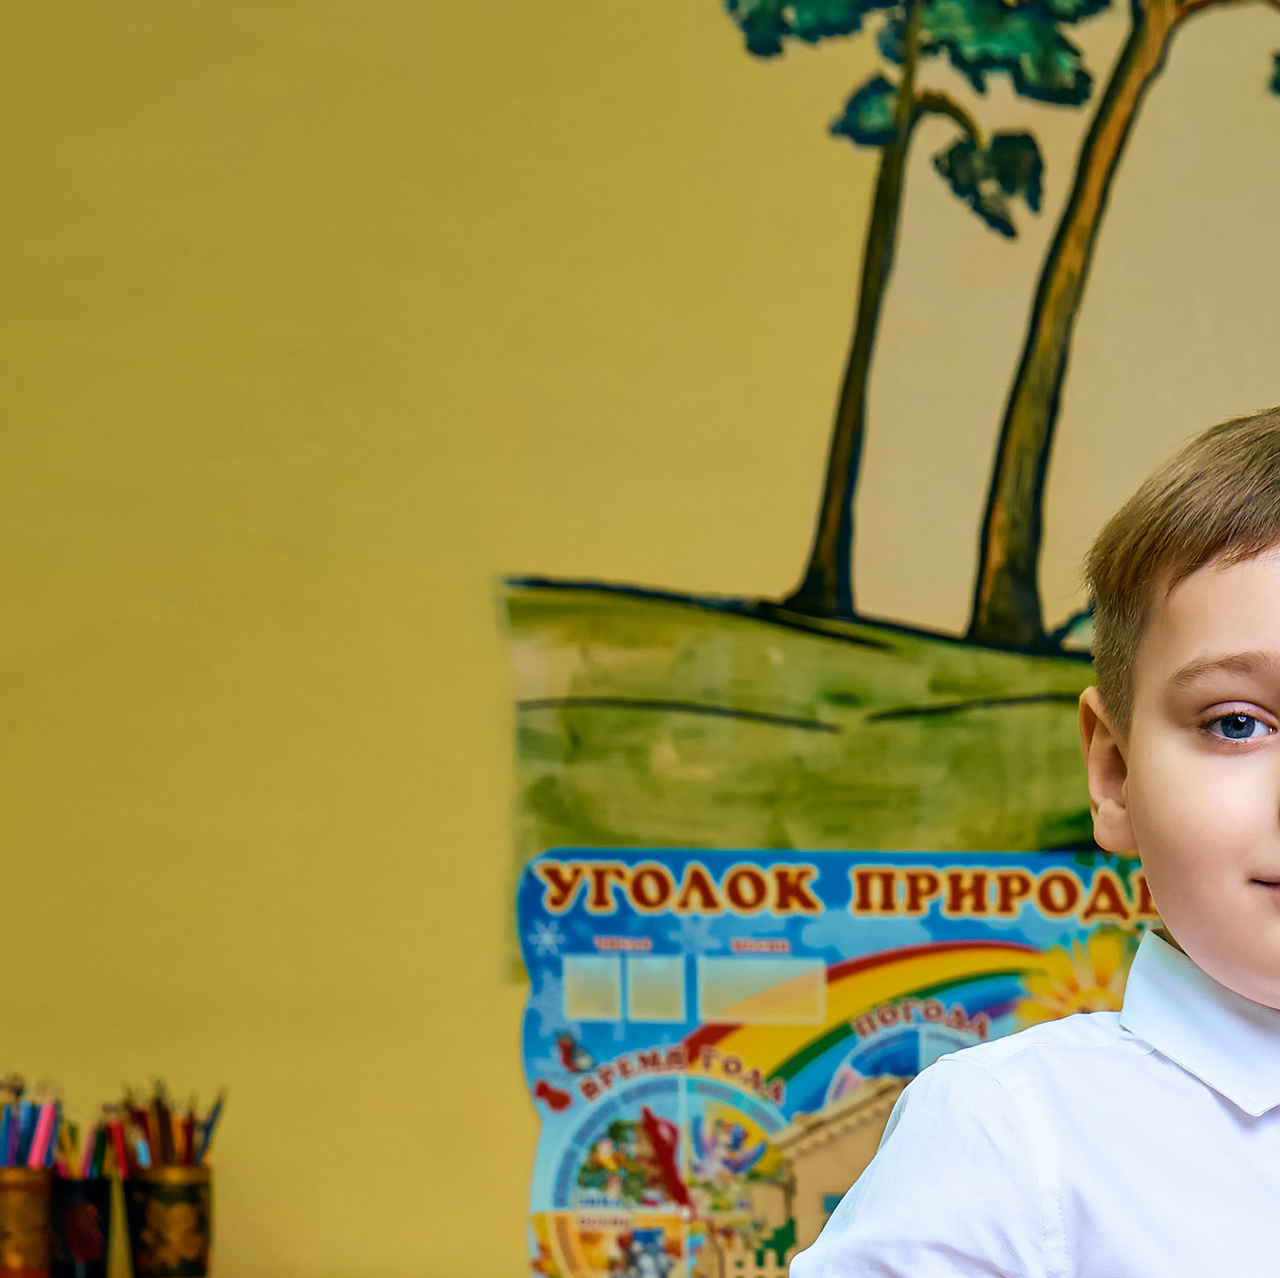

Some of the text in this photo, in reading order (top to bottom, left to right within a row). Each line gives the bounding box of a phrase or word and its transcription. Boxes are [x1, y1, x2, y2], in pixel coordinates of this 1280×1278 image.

[538, 864, 822, 911] УГОЛОК
[852, 998, 989, 1040] ПОГОДА
[699, 1046, 787, 1104] ГОДА
